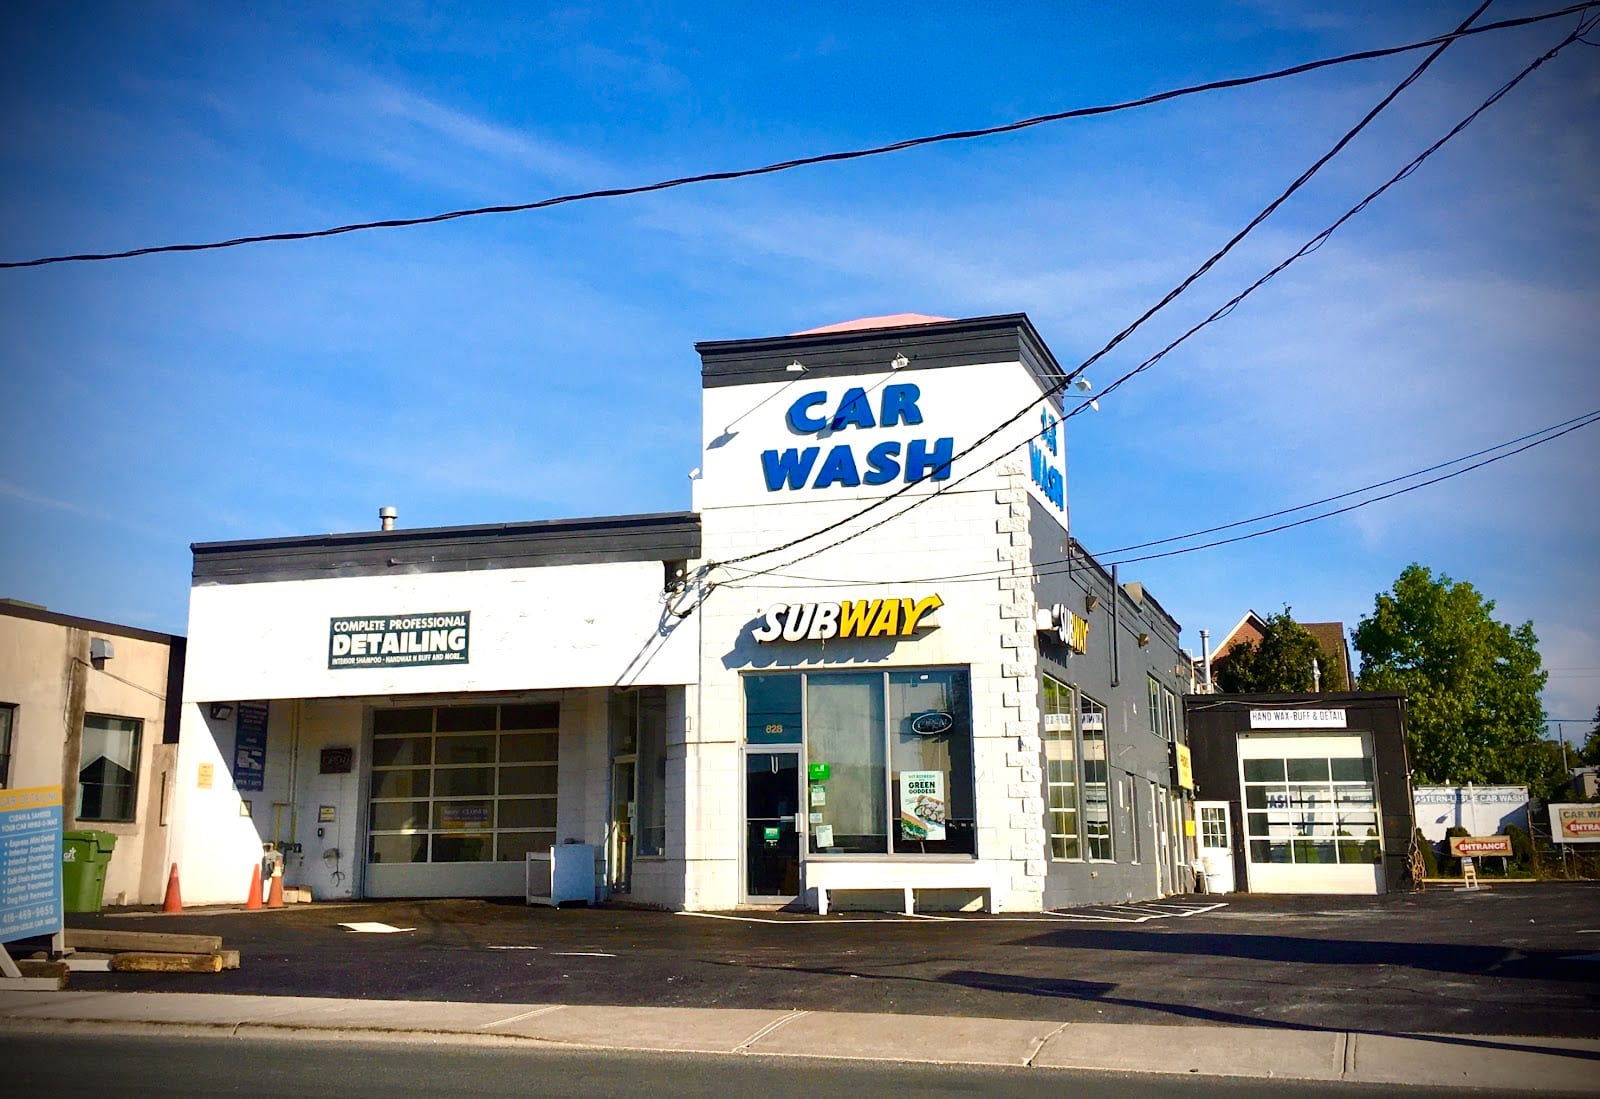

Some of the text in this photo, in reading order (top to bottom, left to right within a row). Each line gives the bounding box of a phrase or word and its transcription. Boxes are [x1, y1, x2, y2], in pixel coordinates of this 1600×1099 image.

[786, 383, 923, 432] CAR
[761, 437, 954, 491] WASH
[1028, 439, 1064, 511] WASH
[333, 616, 466, 632] COMPLETE PROFESSIONAL
[751, 593, 944, 643] SUBWAY
[1058, 603, 1089, 655] SUBWAY
[332, 629, 466, 656] DETAILING
[1252, 711, 1344, 721] HAND WAX-BUFF & DETAIL
[766, 724, 783, 734] 828
[908, 781, 935, 789] GREEN
[1266, 795, 1293, 808] ASH
[1480, 794, 1498, 802] CAR
[1500, 794, 1524, 802] WASH
[1563, 811, 1585, 819] CAR
[1570, 823, 1600, 832] ENTRA
[1459, 843, 1507, 851] ENTRANCE
